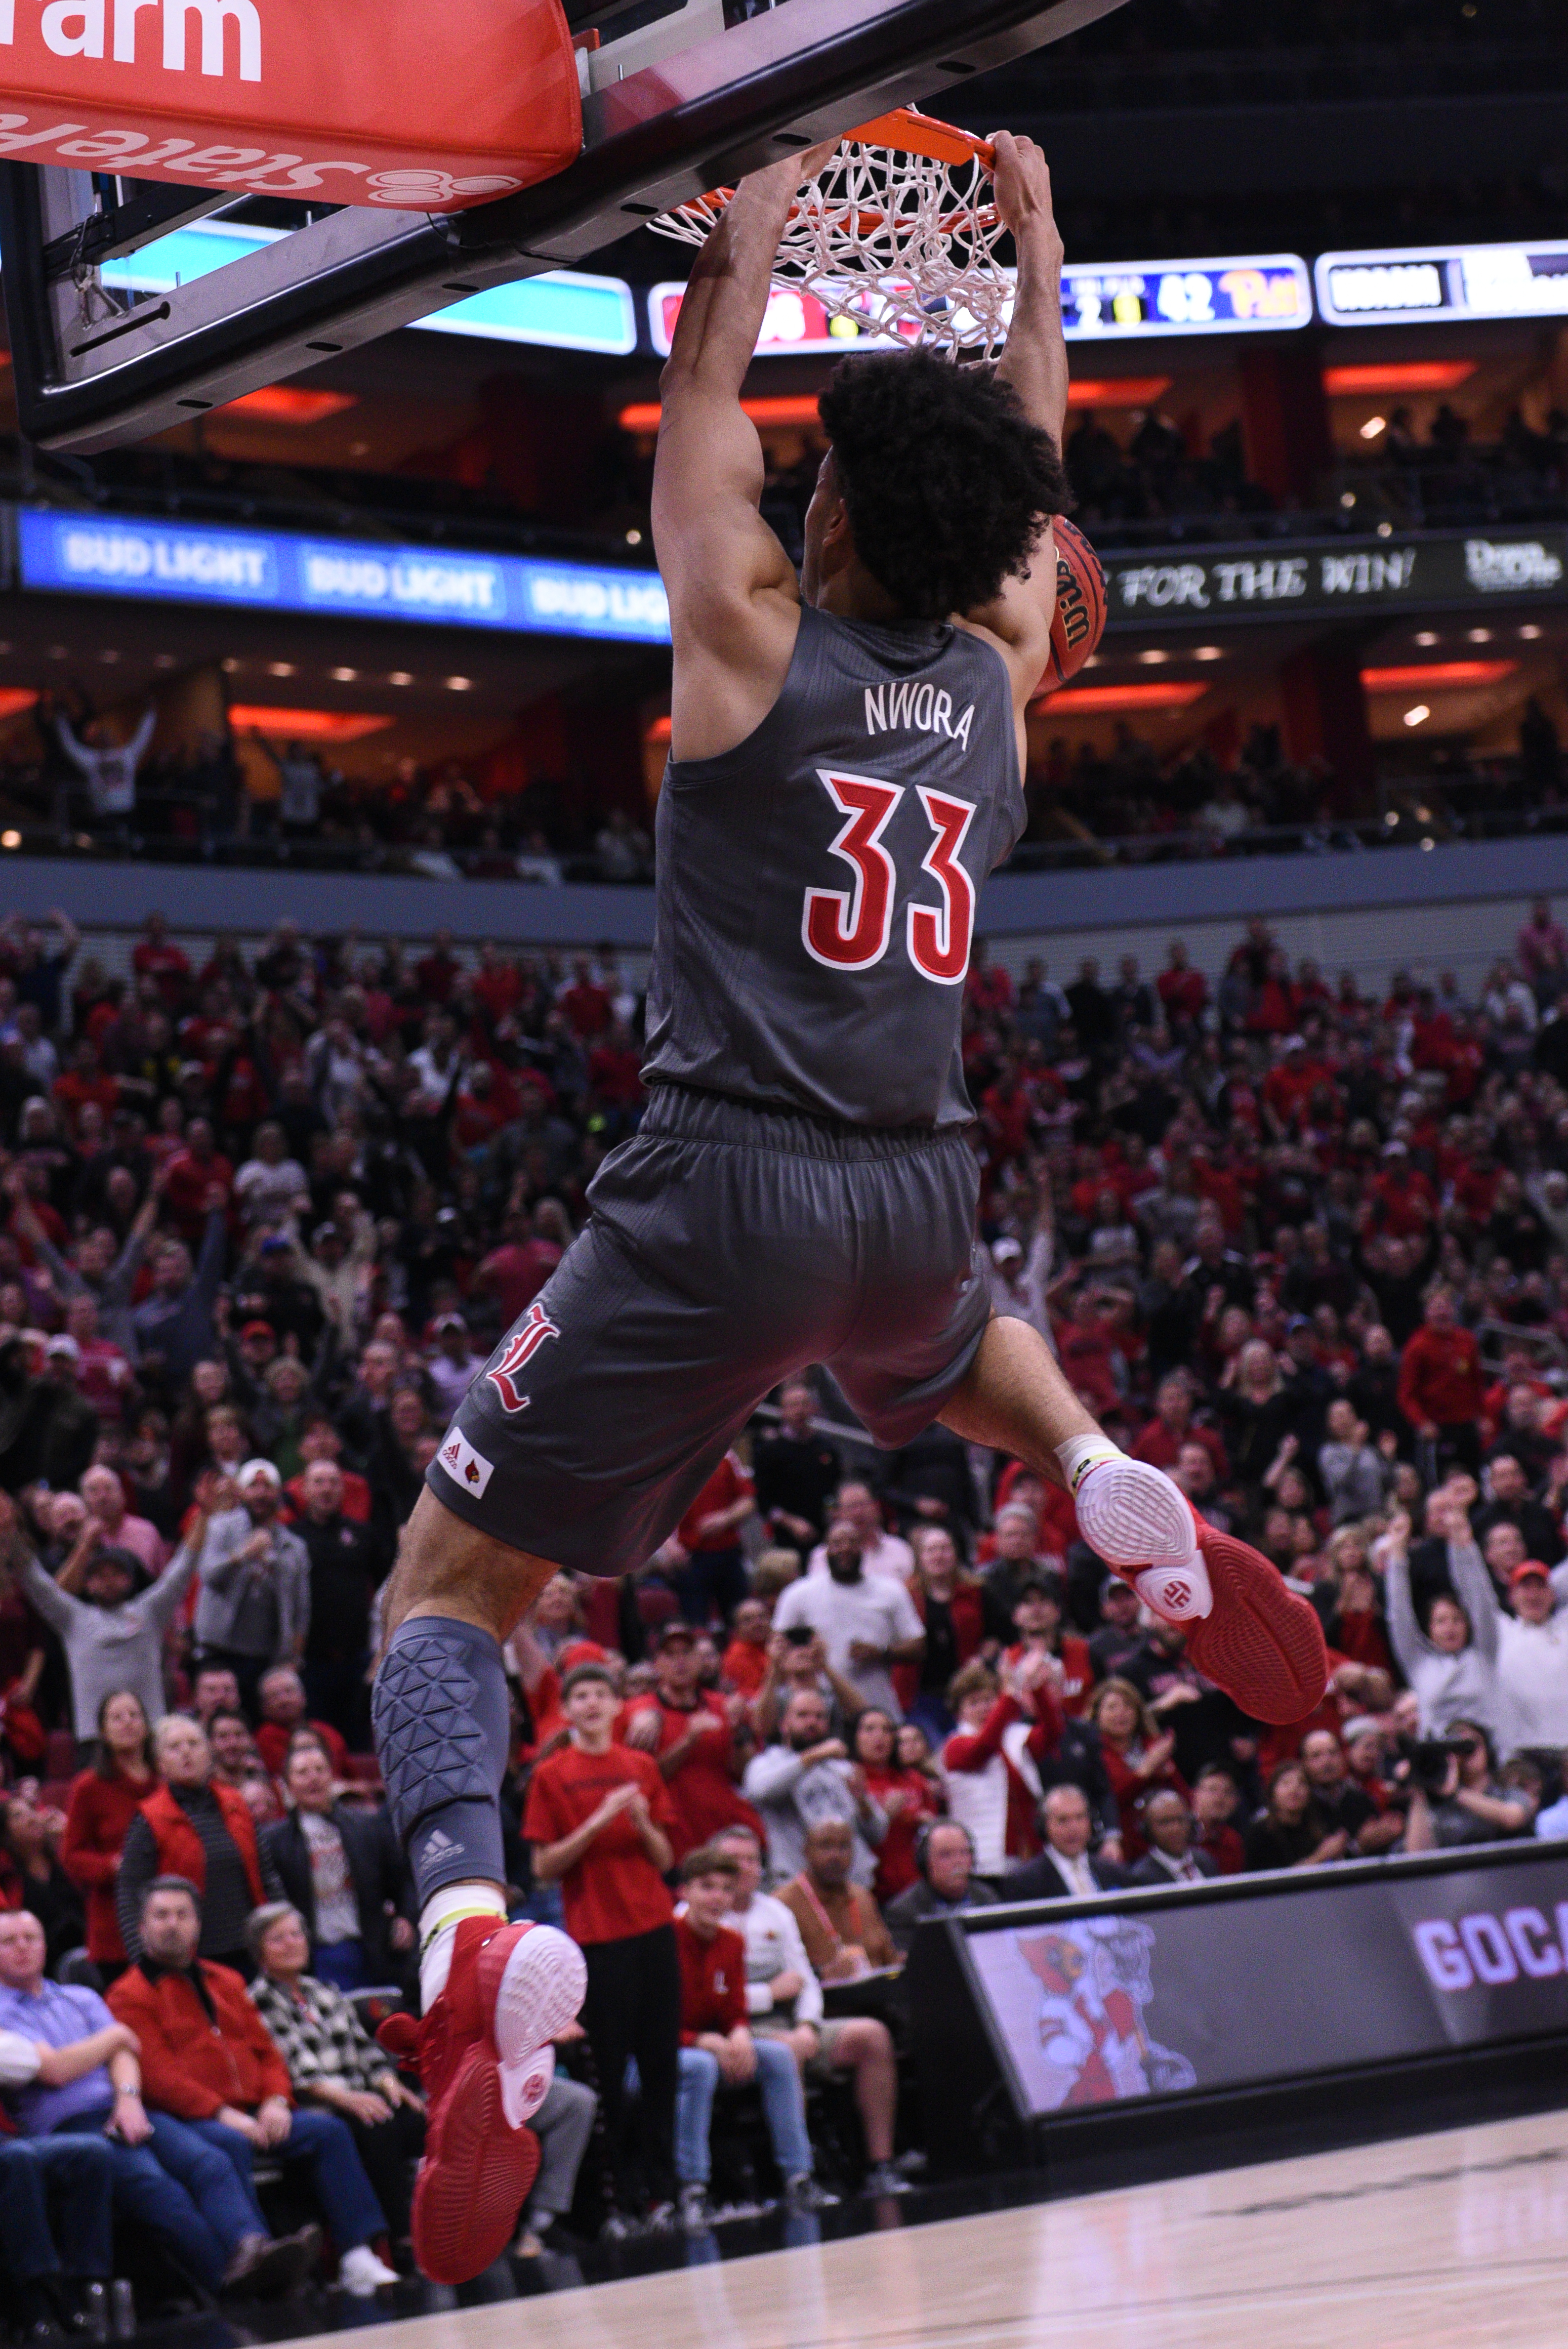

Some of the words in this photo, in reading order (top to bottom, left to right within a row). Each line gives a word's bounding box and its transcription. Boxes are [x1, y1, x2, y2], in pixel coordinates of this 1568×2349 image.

[0, 0, 261, 82] arm
[67, 533, 150, 577] BUD
[154, 540, 265, 587] LIGHT
[310, 558, 388, 599] BUD
[390, 564, 496, 608] LIGHT
[1116, 564, 1211, 608] FOR
[1212, 557, 1308, 601] THE
[1320, 547, 1416, 594] WIN!
[532, 578, 606, 619] BUD
[610, 584, 669, 625] LIG
[864, 683, 975, 752] NWORA
[801, 768, 977, 985] 33
